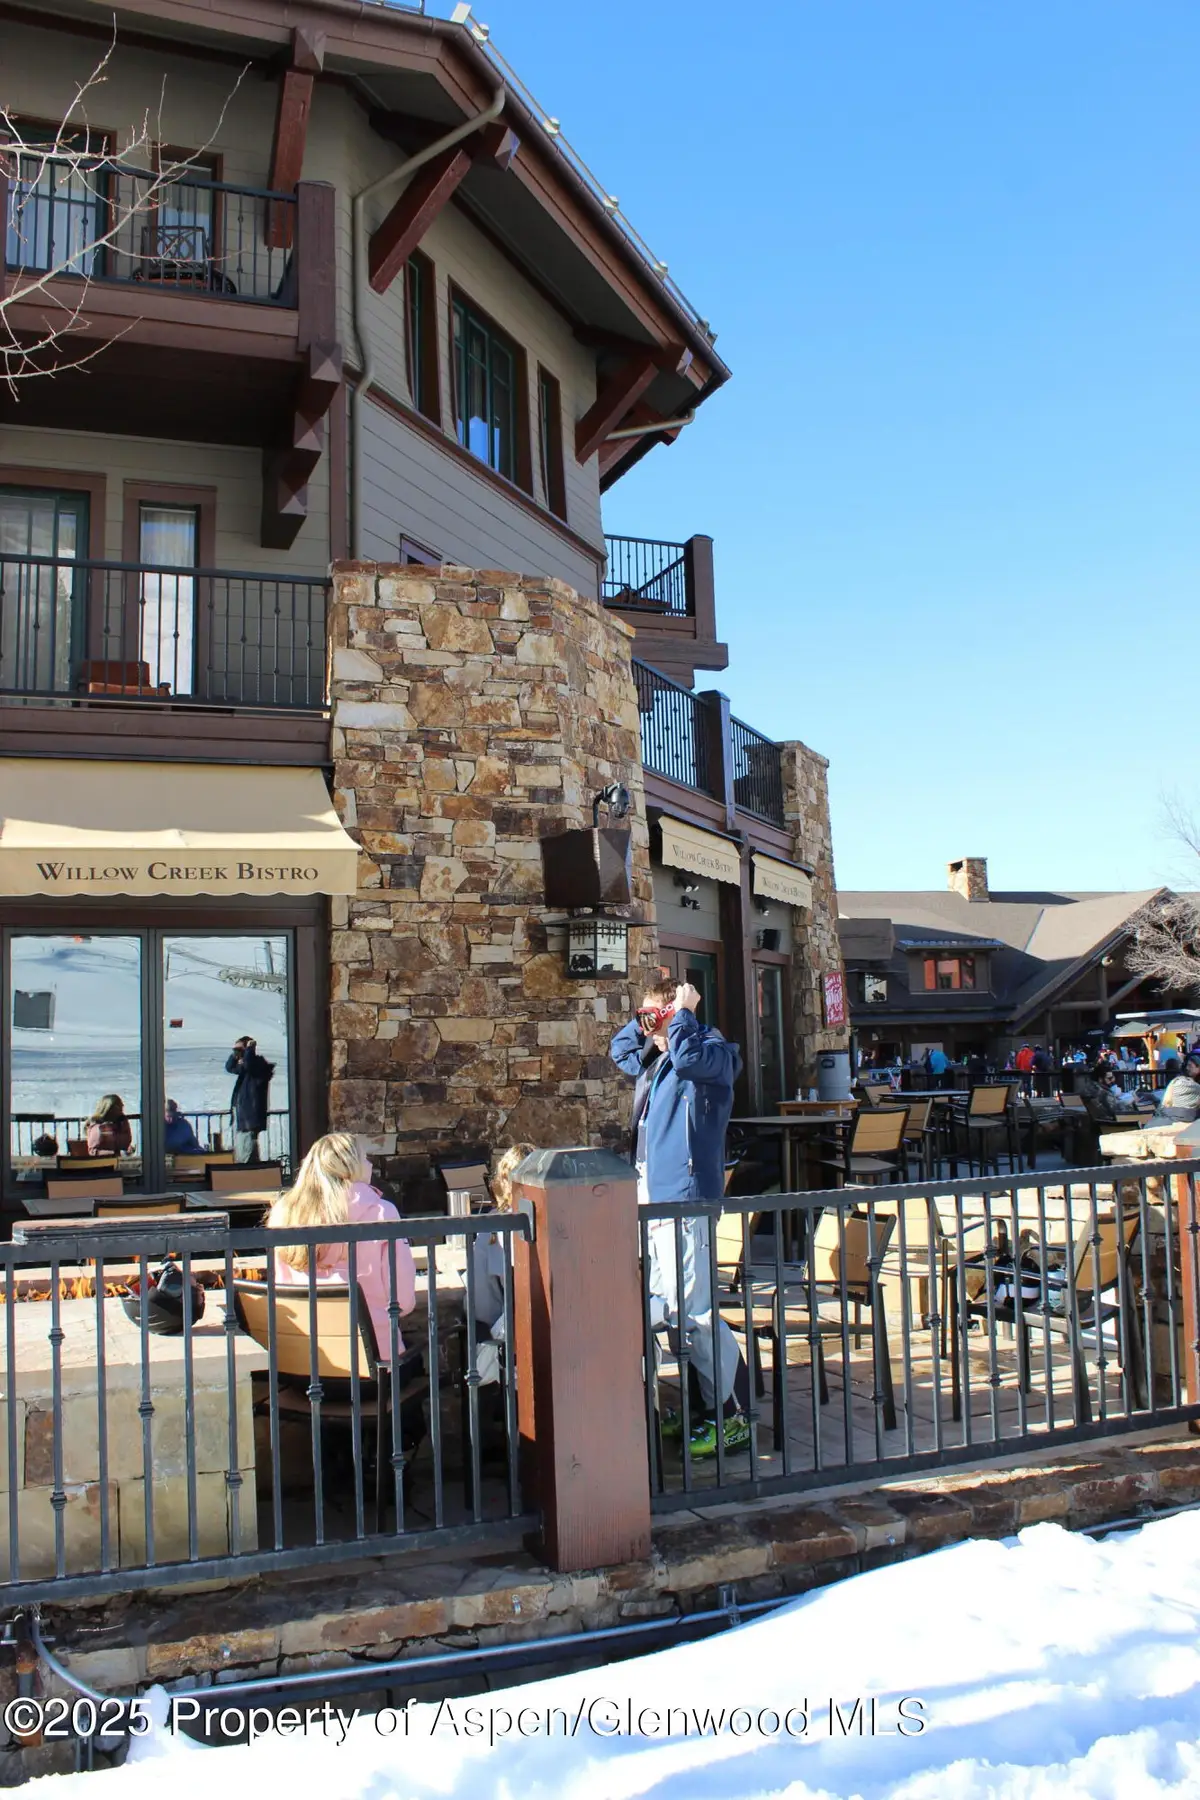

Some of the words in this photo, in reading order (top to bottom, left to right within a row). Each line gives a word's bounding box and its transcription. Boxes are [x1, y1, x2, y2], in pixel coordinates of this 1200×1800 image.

[36, 862, 139, 881] WILLOW
[147, 861, 229, 881] CREEK
[236, 862, 319, 881] BISTRO
